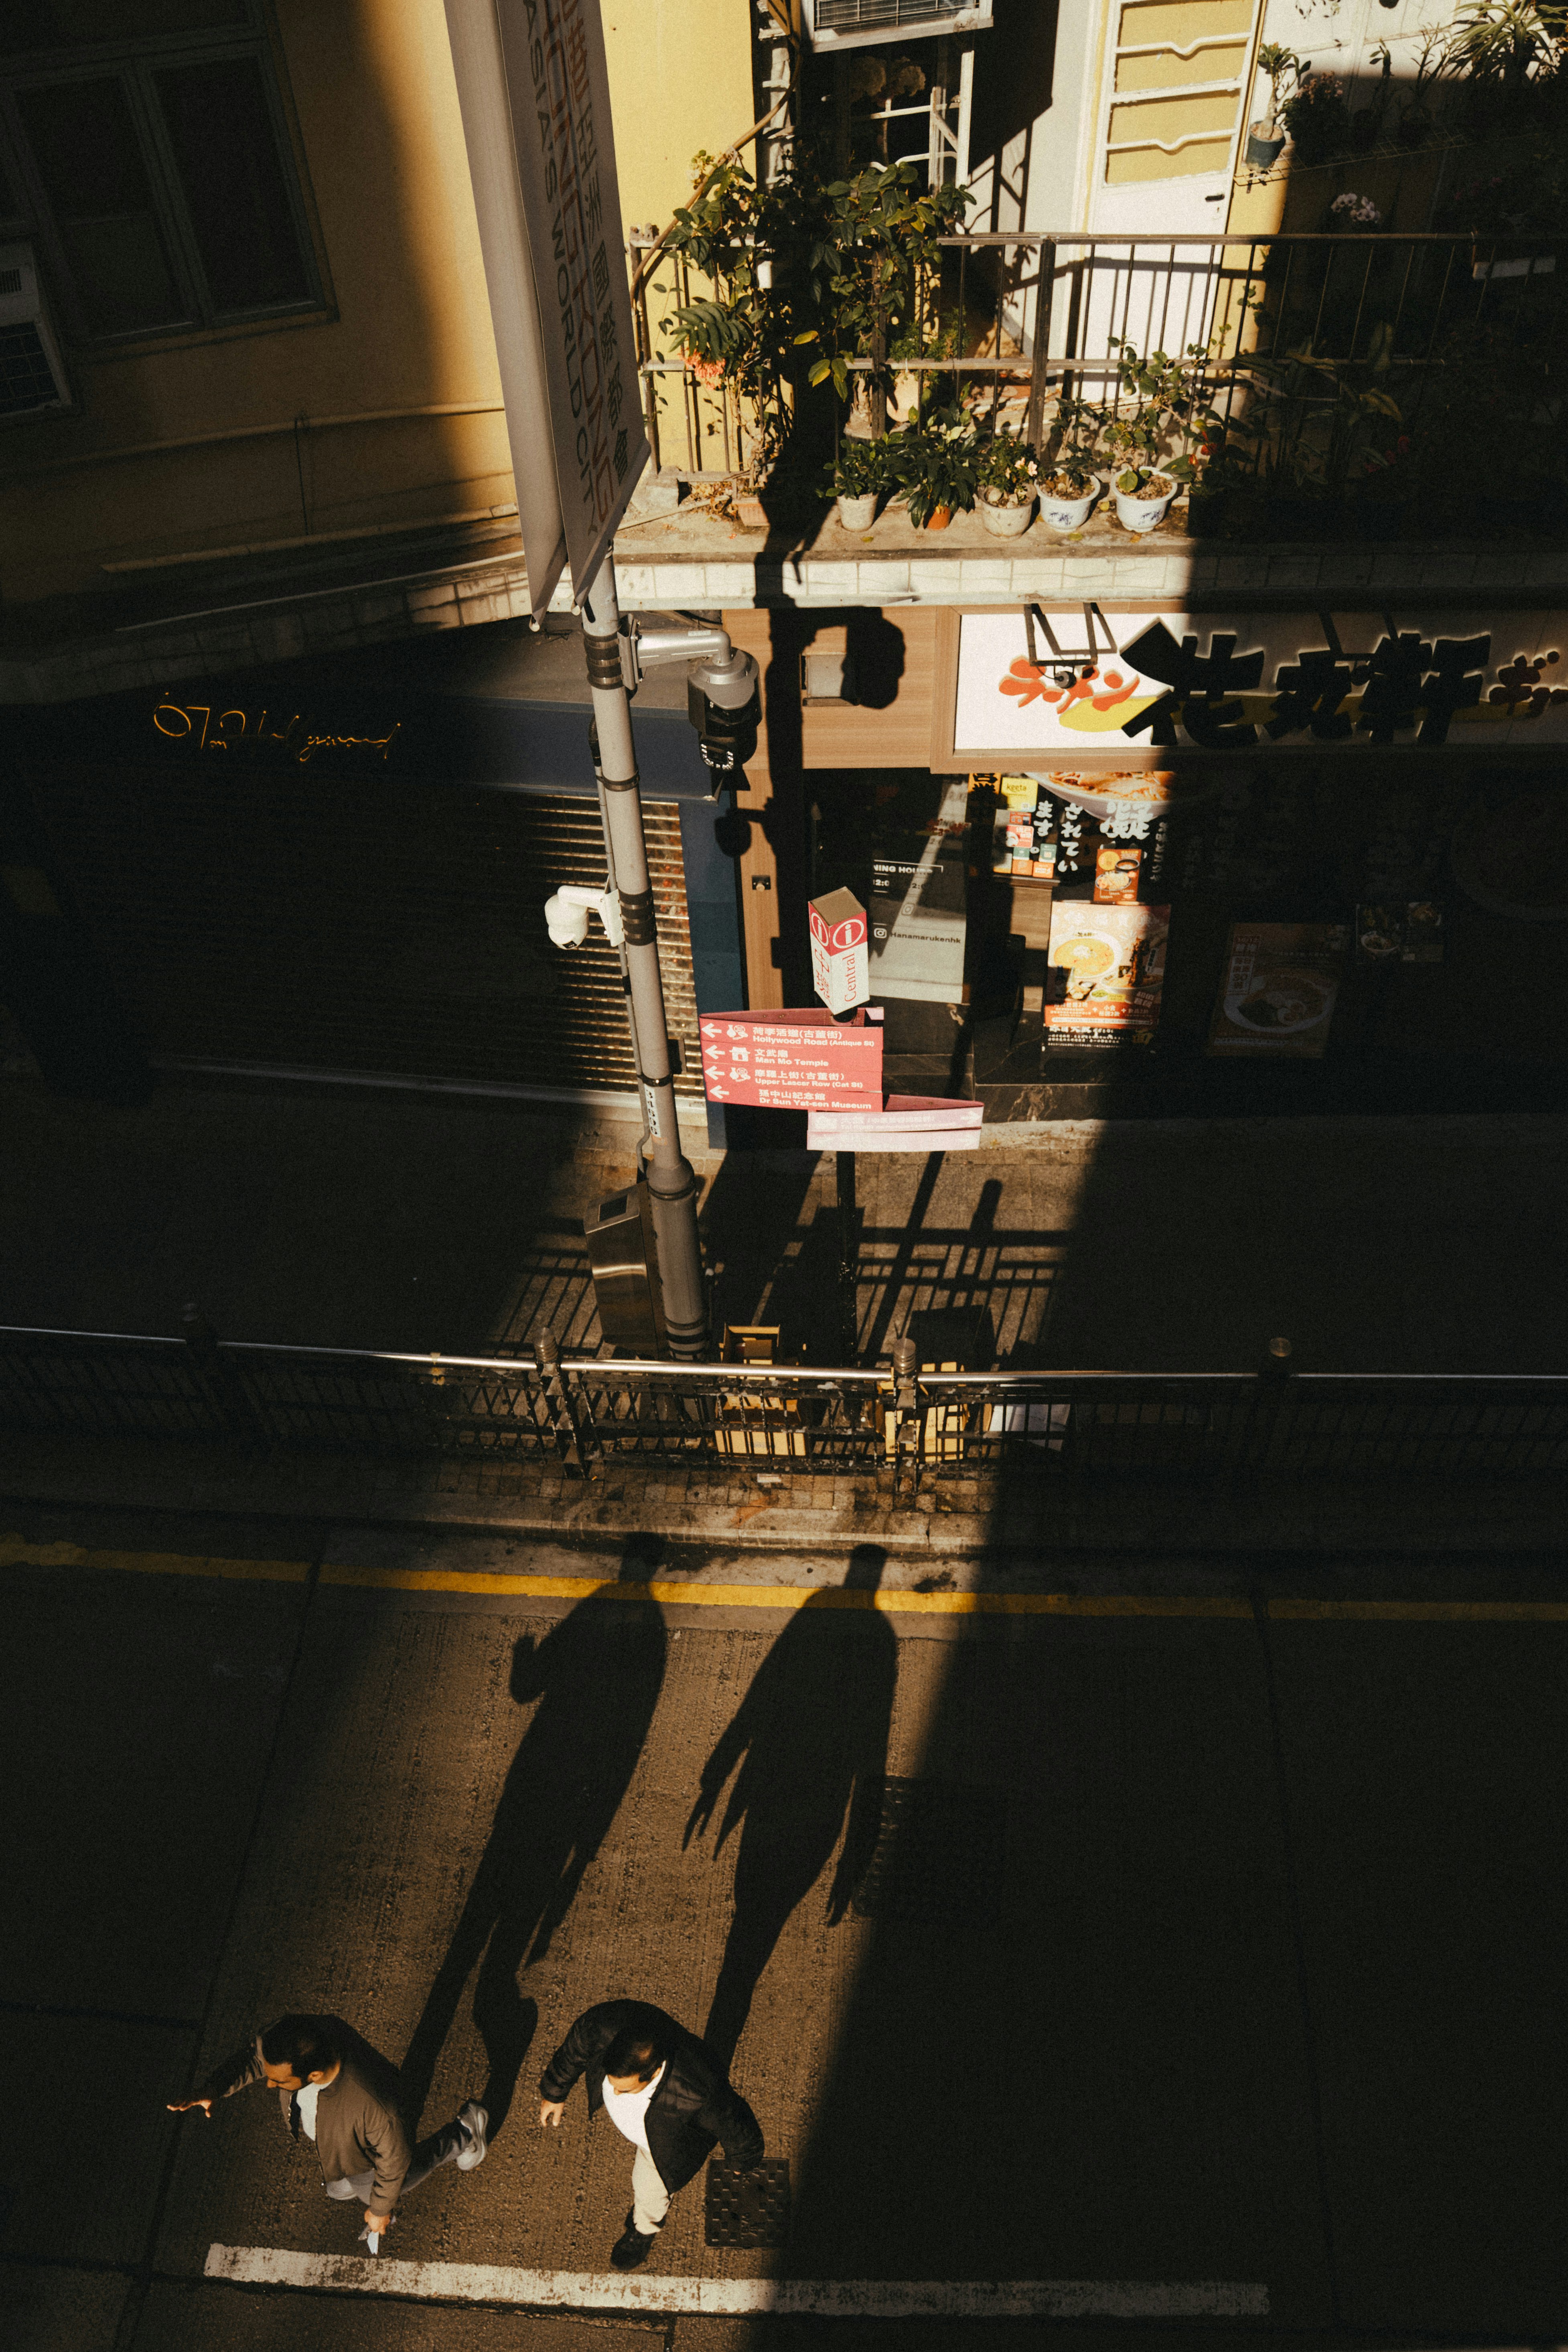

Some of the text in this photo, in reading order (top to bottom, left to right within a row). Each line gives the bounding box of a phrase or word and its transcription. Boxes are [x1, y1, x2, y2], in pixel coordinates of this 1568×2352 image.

[552, 207, 582, 418] WORLD
[576, 426, 598, 537] CITY
[572, 269, 614, 522] KONG
[1007, 783, 1026, 791] keeta
[873, 864, 896, 872] NING
[842, 953, 856, 1002] Central
[753, 1027, 842, 1040] 荷李活道(古董街)
[753, 1036, 801, 1044] Hollywood
[755, 1048, 788, 1058] 文武廟
[794, 1059, 829, 1067] Temple
[759, 1089, 826, 1101] 孫中山紀念館
[793, 1099, 829, 1107] Yat-sen
